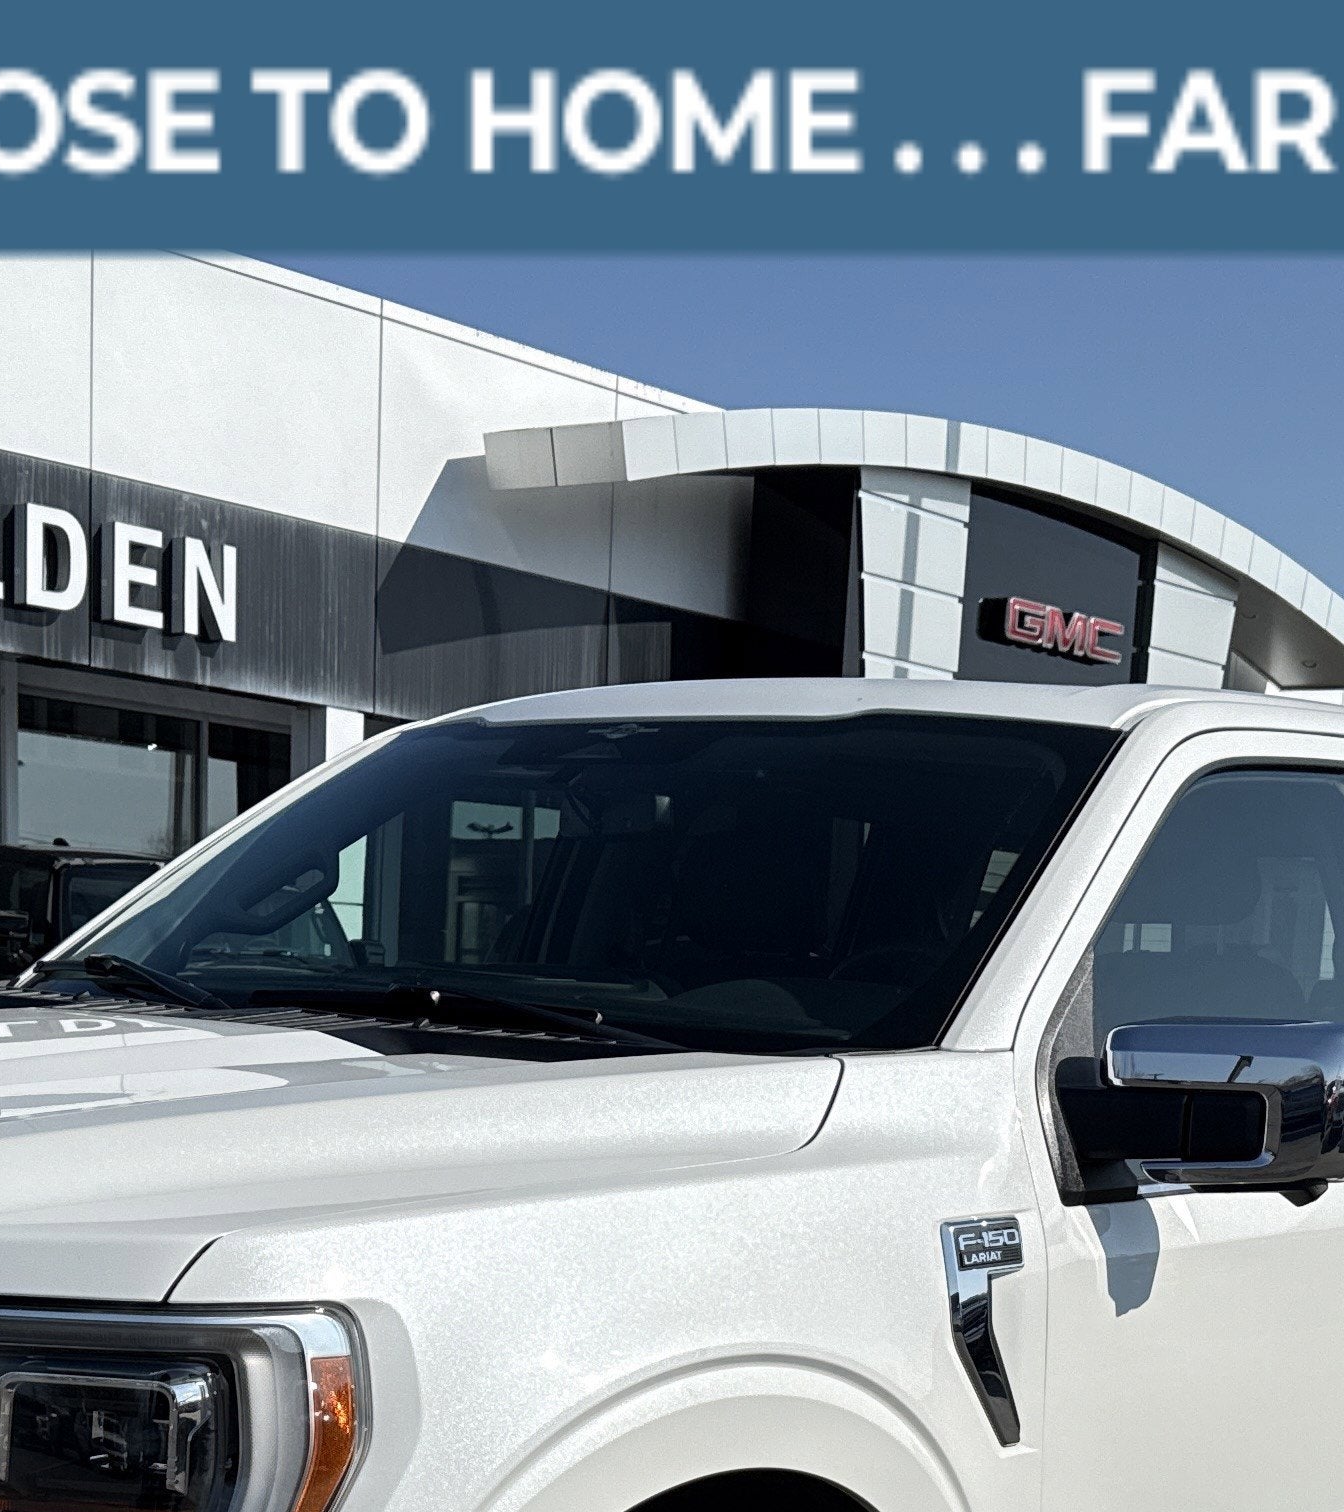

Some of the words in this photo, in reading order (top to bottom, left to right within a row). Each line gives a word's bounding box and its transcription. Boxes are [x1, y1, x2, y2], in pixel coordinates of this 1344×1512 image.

[1004, 596, 1126, 666] GMC
[958, 1228, 1020, 1251] F-150
[963, 1250, 1003, 1265] LARIAT
